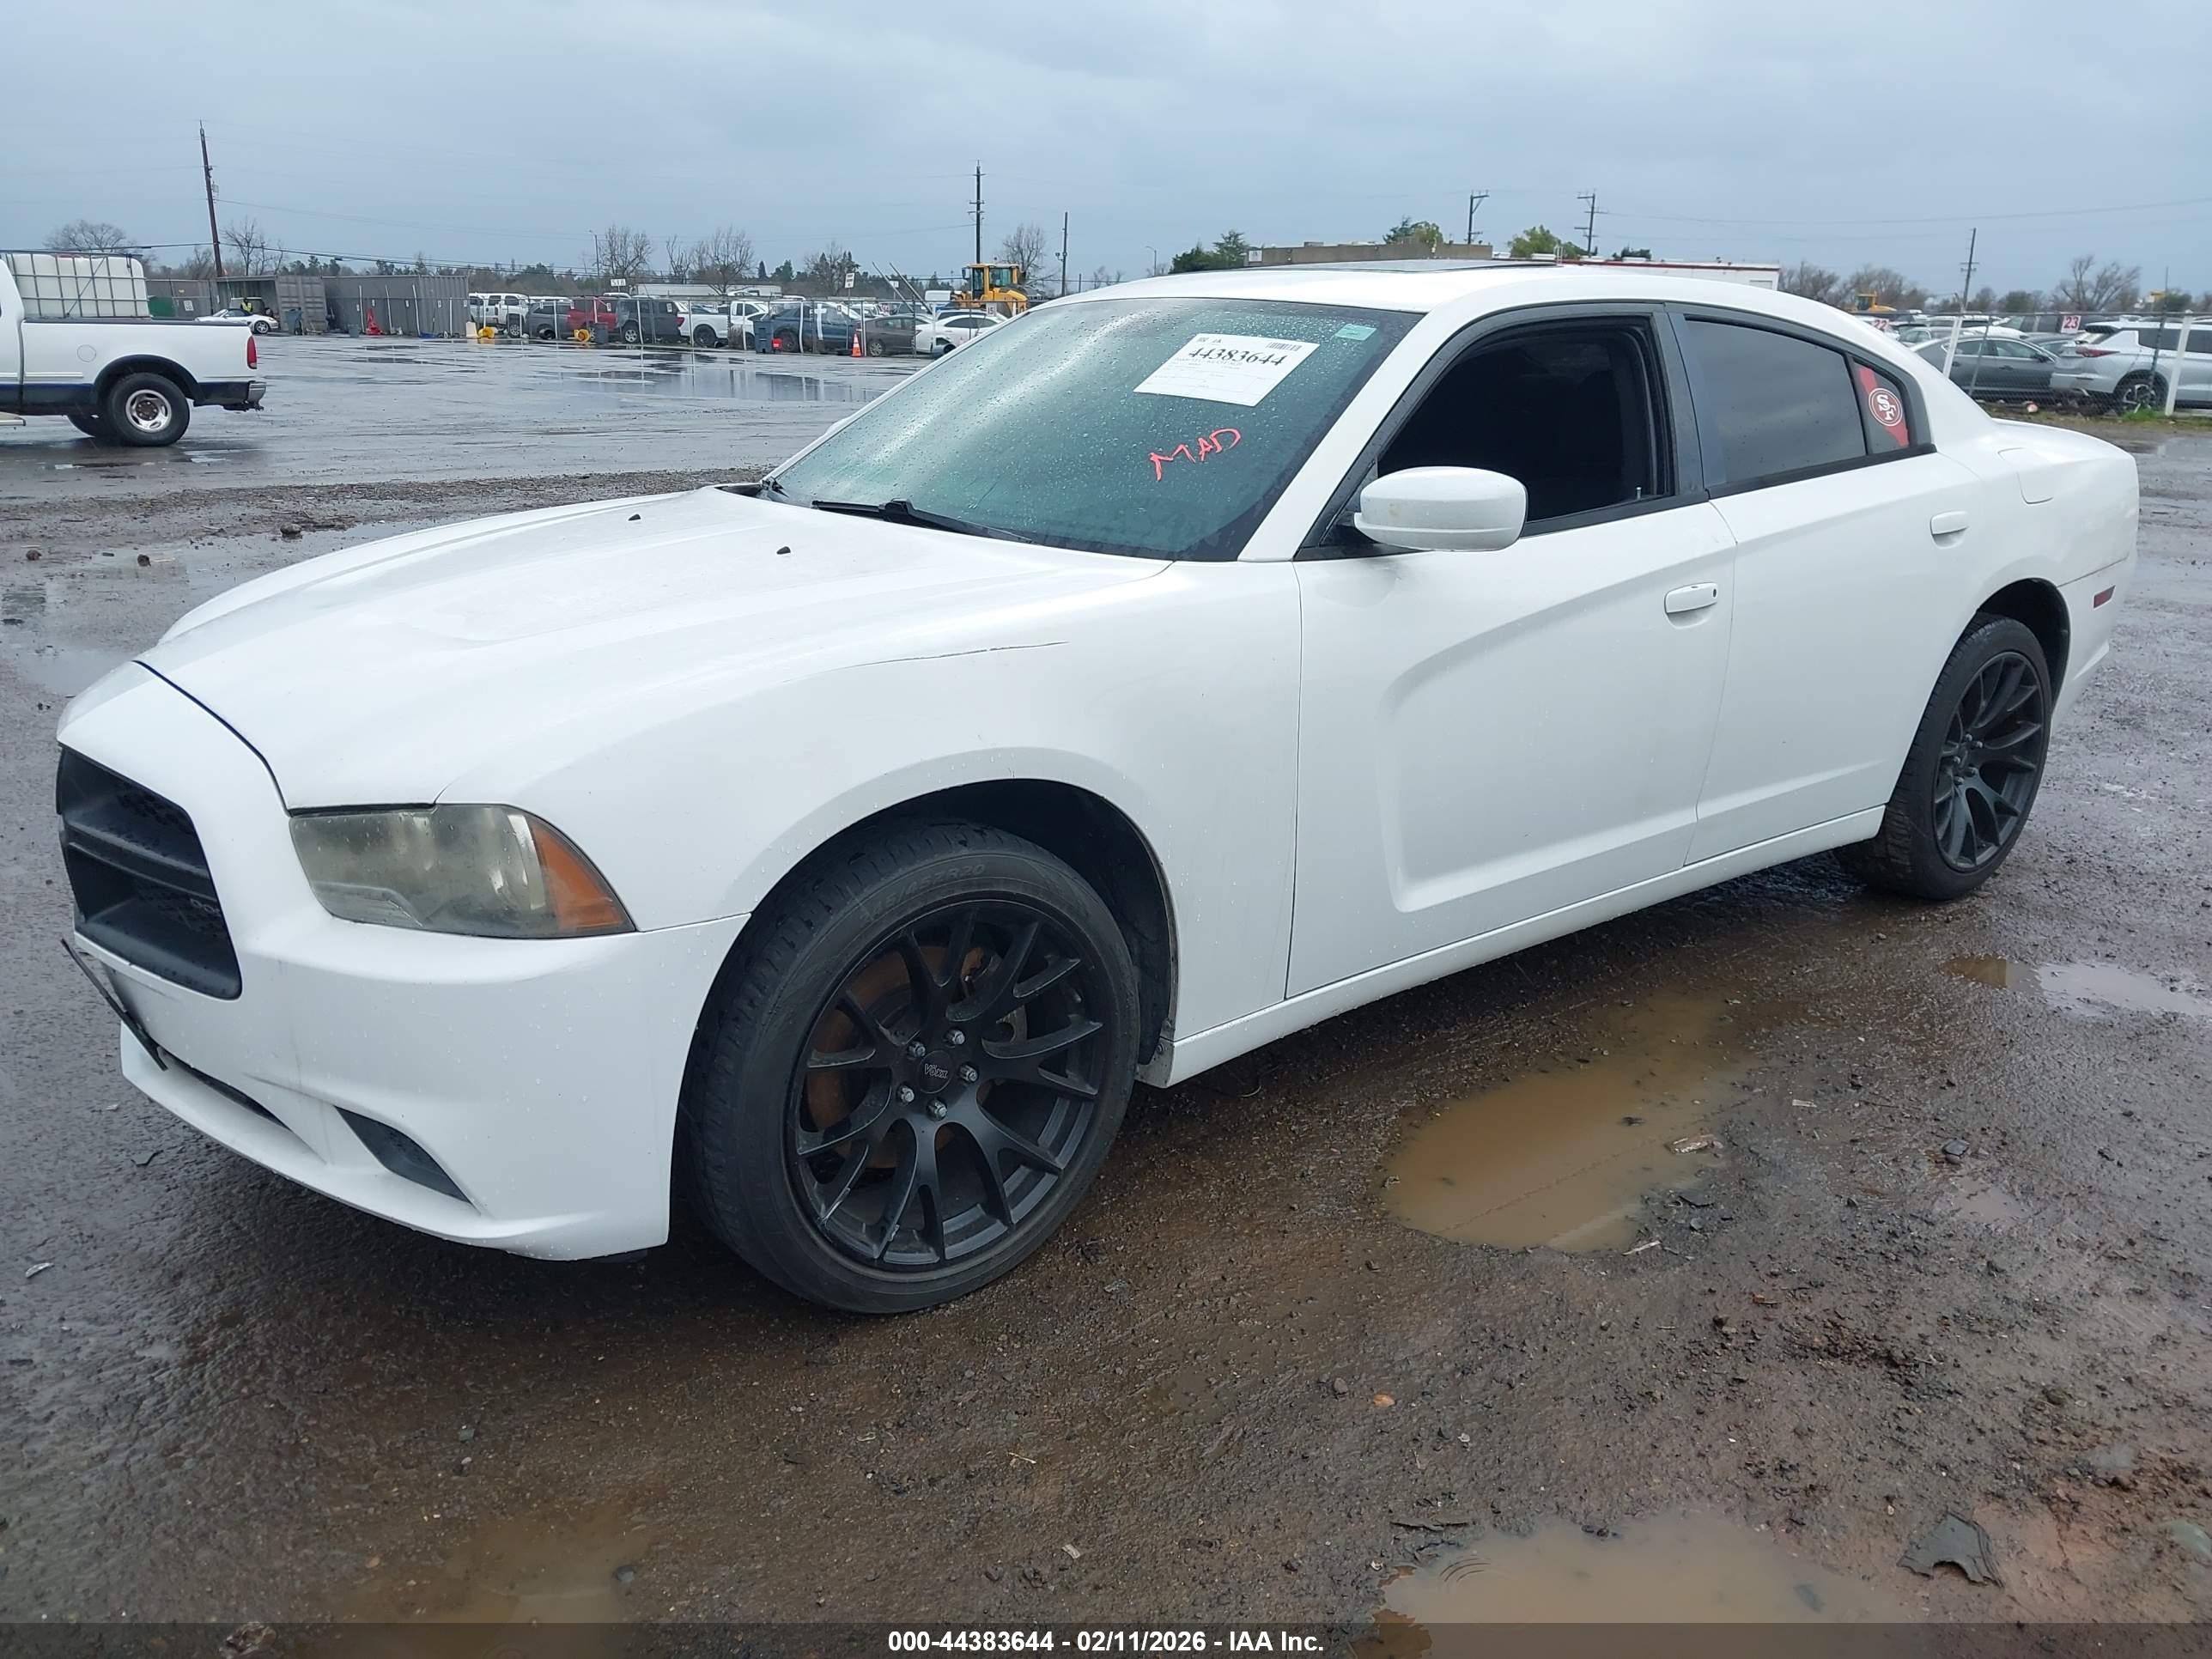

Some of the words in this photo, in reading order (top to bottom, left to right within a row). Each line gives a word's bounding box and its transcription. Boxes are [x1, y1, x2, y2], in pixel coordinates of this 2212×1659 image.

[2063, 317, 2079, 329] 23
[1189, 348, 1288, 366] 44383644
[1149, 428, 1241, 480] MAD
